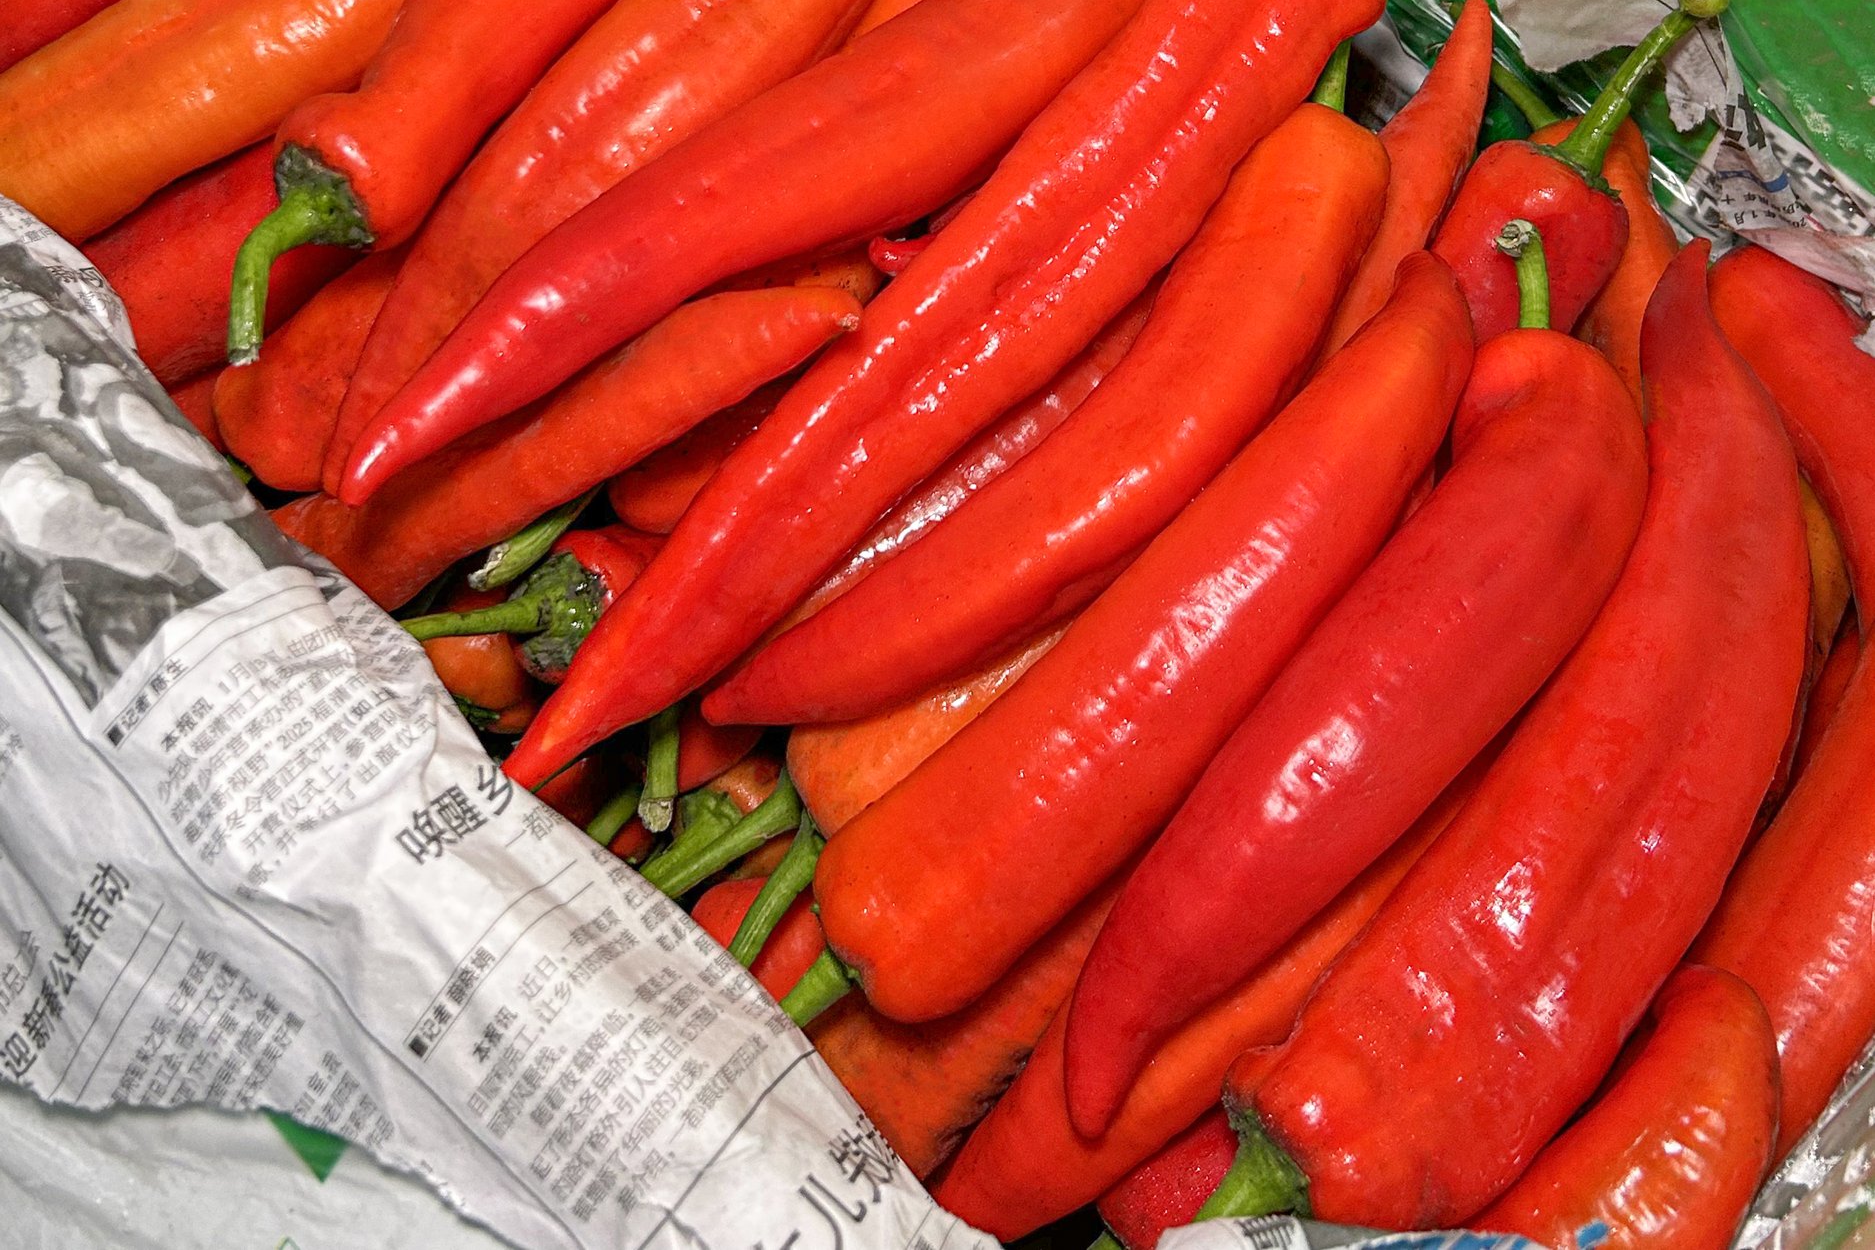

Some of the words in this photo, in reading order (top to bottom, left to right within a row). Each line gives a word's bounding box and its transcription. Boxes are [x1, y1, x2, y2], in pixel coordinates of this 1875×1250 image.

[118, 692, 153, 730] 记者
[157, 695, 215, 752] 本报讯
[394, 763, 516, 865] 唤醒乡
[418, 1002, 454, 1043] 记者
[468, 1004, 519, 1064] 本报讯
